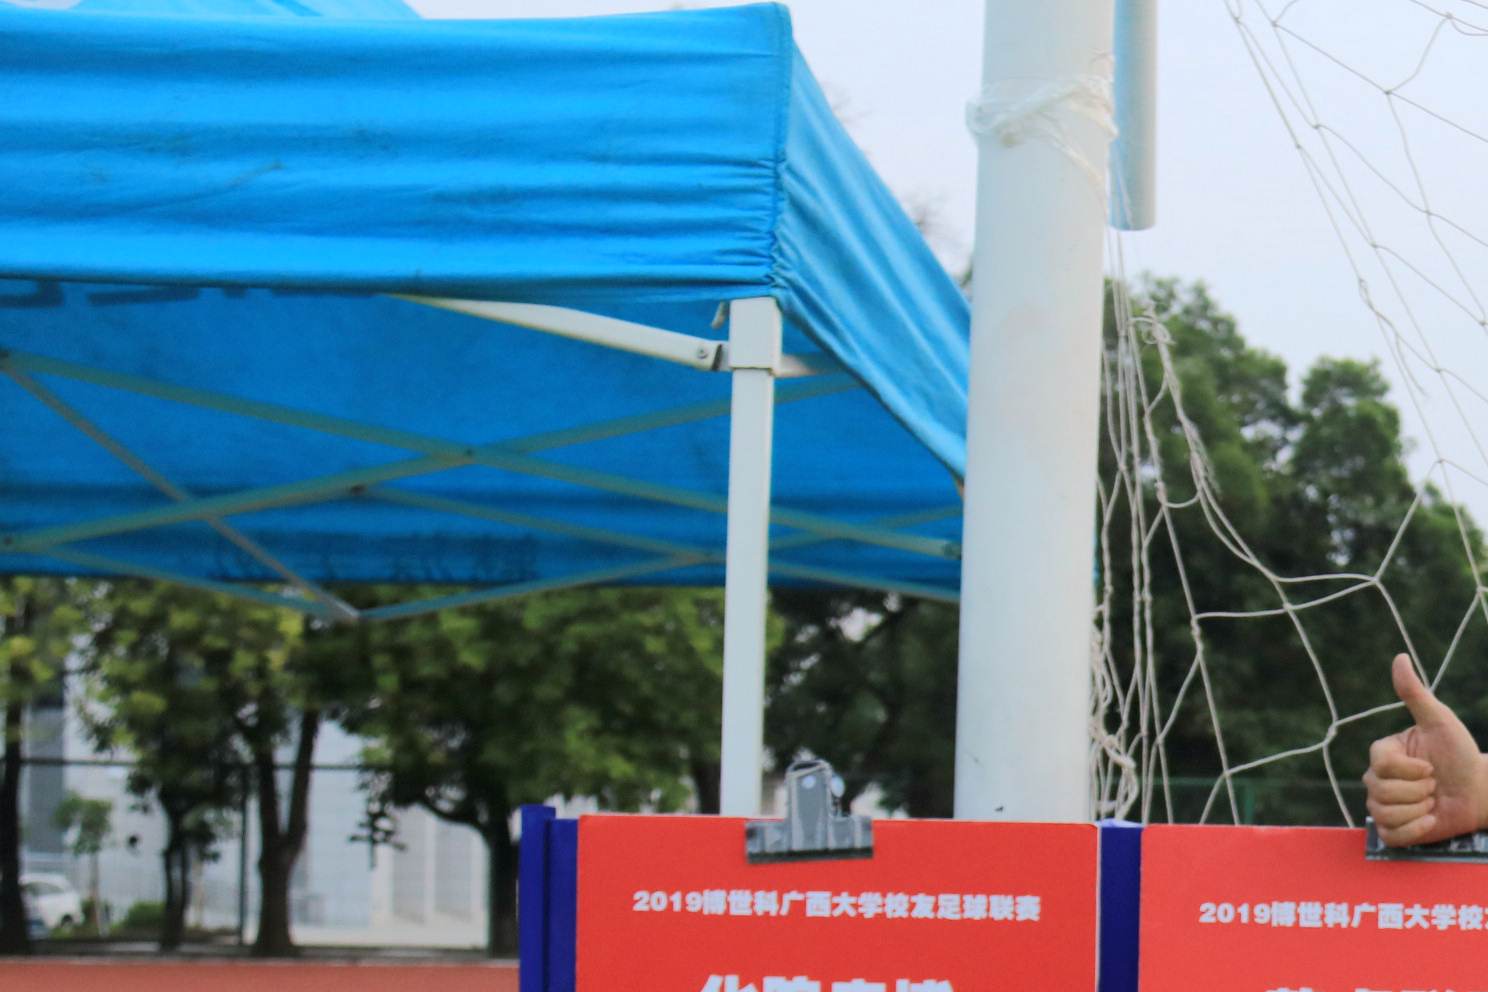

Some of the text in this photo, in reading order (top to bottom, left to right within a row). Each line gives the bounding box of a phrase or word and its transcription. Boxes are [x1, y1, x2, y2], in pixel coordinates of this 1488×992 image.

[634, 891, 1041, 921] 2019博世科广西大学校友足球联赛
